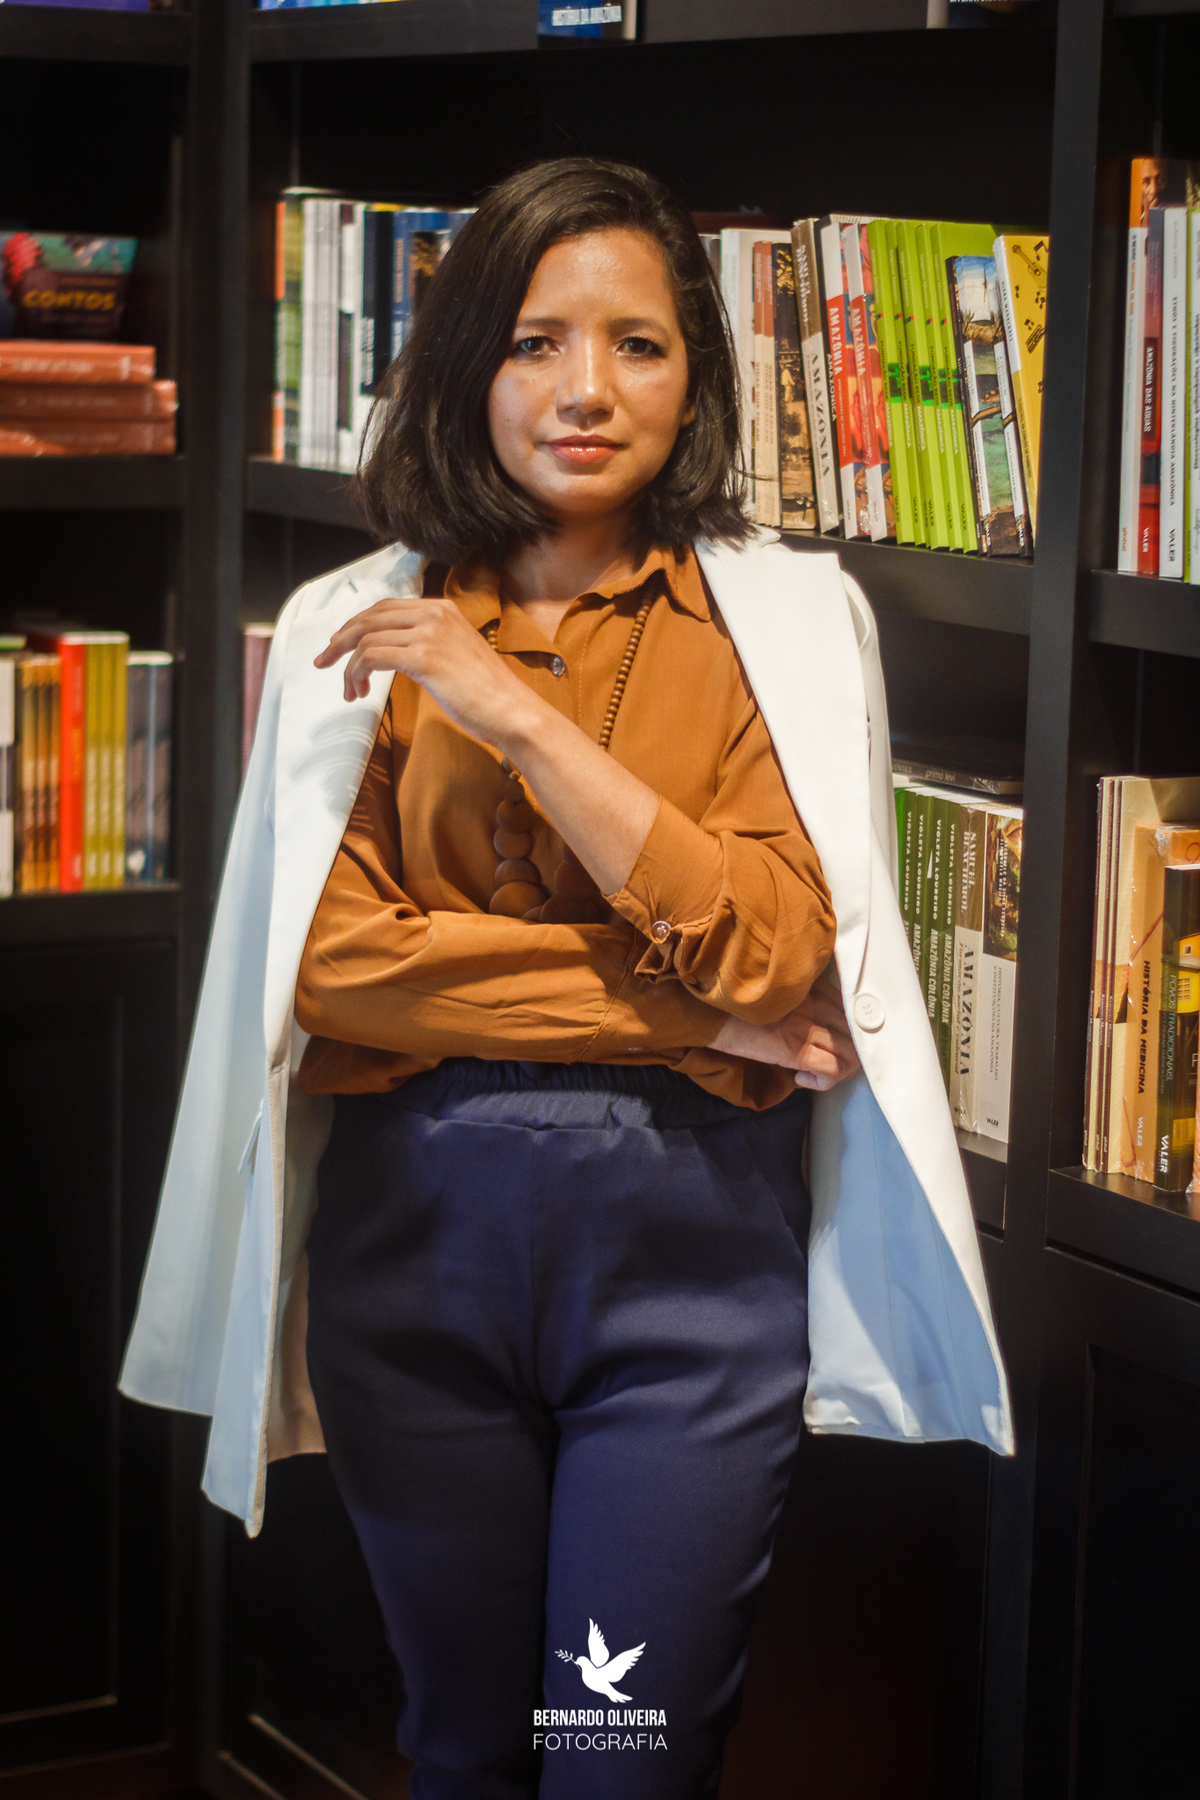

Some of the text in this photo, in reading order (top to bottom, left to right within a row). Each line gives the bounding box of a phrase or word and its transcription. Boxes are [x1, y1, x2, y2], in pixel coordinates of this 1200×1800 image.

[22, 290, 116, 310] CONTOS
[828, 307, 844, 374] AMAZÔNIA
[852, 307, 865, 375] AMAZÔNIA
[1144, 346, 1153, 385] AMAZÔNIA
[1170, 384, 1177, 397] NA
[811, 353, 830, 476] AMAZÔNIA
[884, 402, 893, 447] AMAZÔNICA
[902, 402, 912, 447] AMAZÔNICA
[916, 405, 926, 450] AMAZÔNICA
[935, 408, 945, 453] AMAZÔNICA
[950, 409, 959, 454] AMAZÔNICA
[926, 770, 955, 782] primo levi
[926, 928, 938, 1017] AMAZÔNIA COLÔNIA
[942, 934, 953, 982] AMAZÔNIA
[940, 983, 950, 1023] COLÔNIA
[959, 945, 976, 1075] AMAZÔNIA
[1137, 960, 1151, 1094] HISTÓRIA DA MEDICINA
[1164, 1012, 1174, 1081] TRADICIONAIS,
[1135, 1116, 1144, 1147] VALER
[1158, 1134, 1169, 1173] VALER
